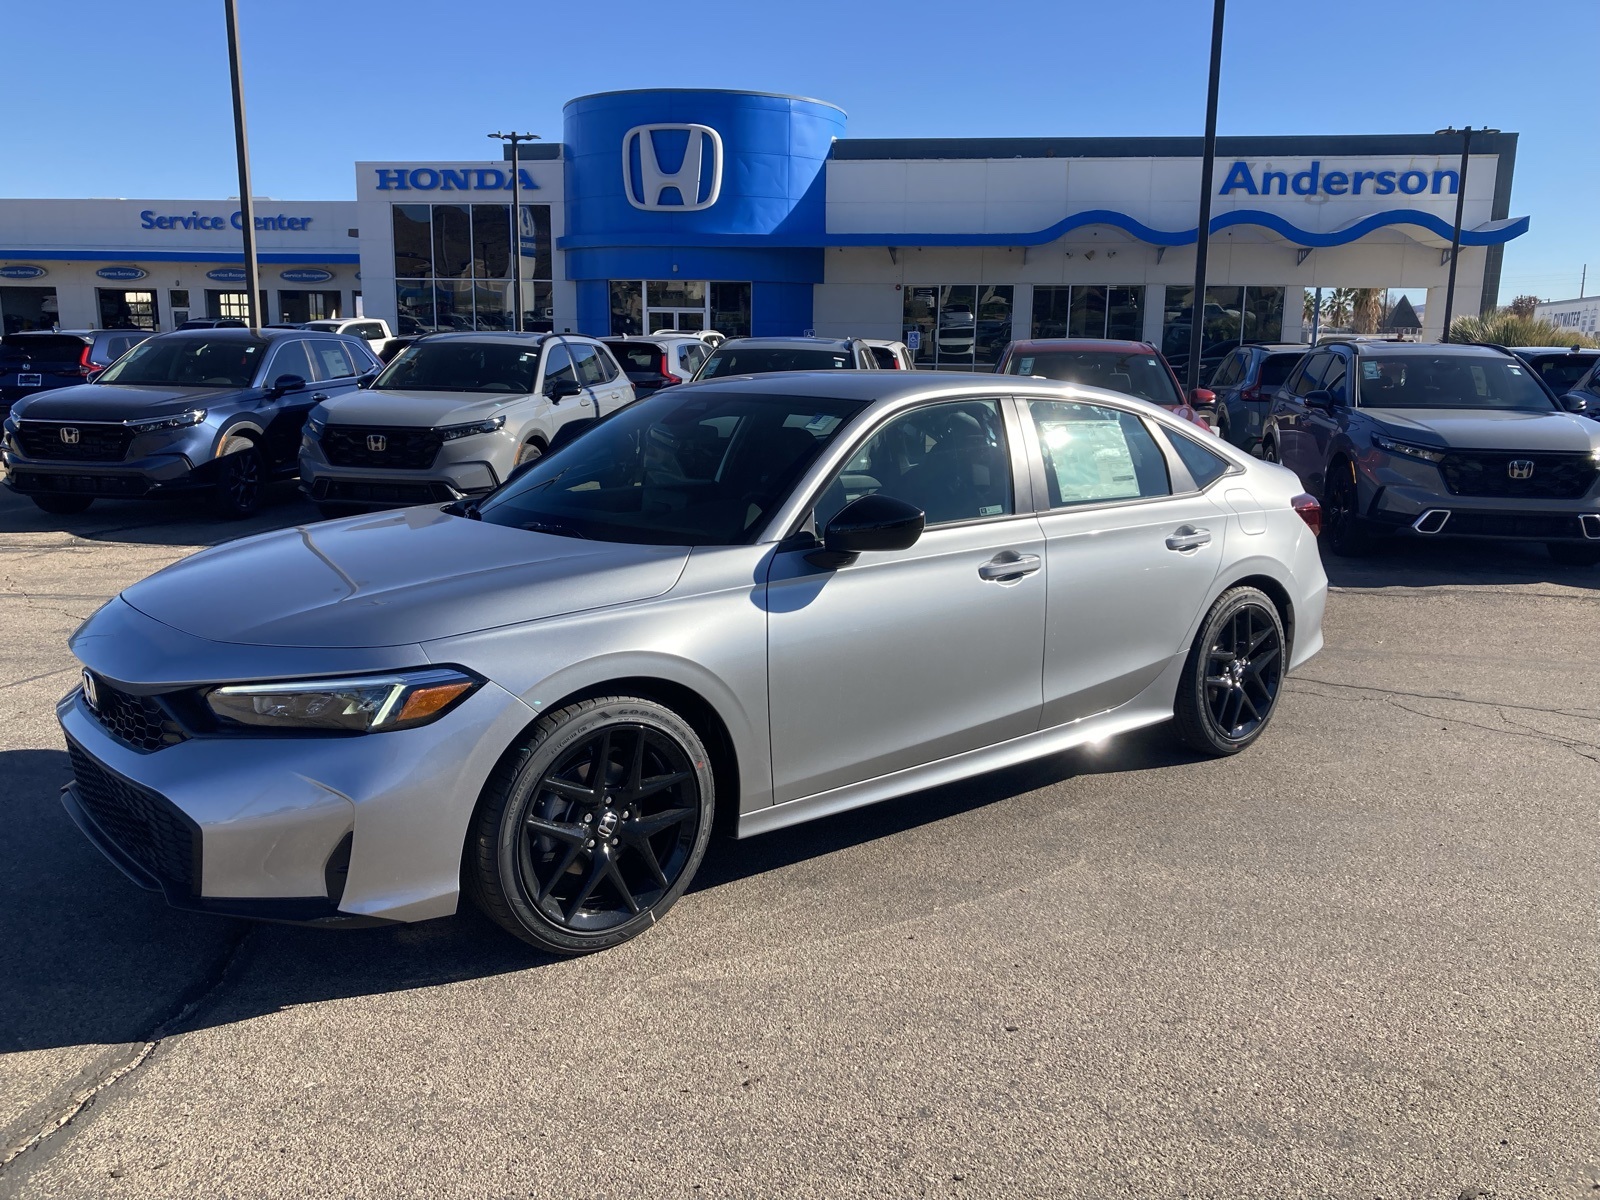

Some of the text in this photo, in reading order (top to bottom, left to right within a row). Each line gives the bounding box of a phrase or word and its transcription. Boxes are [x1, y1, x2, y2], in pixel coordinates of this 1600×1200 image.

[375, 168, 540, 190] HONDA
[1219, 161, 1459, 196] Anderson
[140, 210, 313, 231] Service Center
[98, 270, 117, 278] Express
